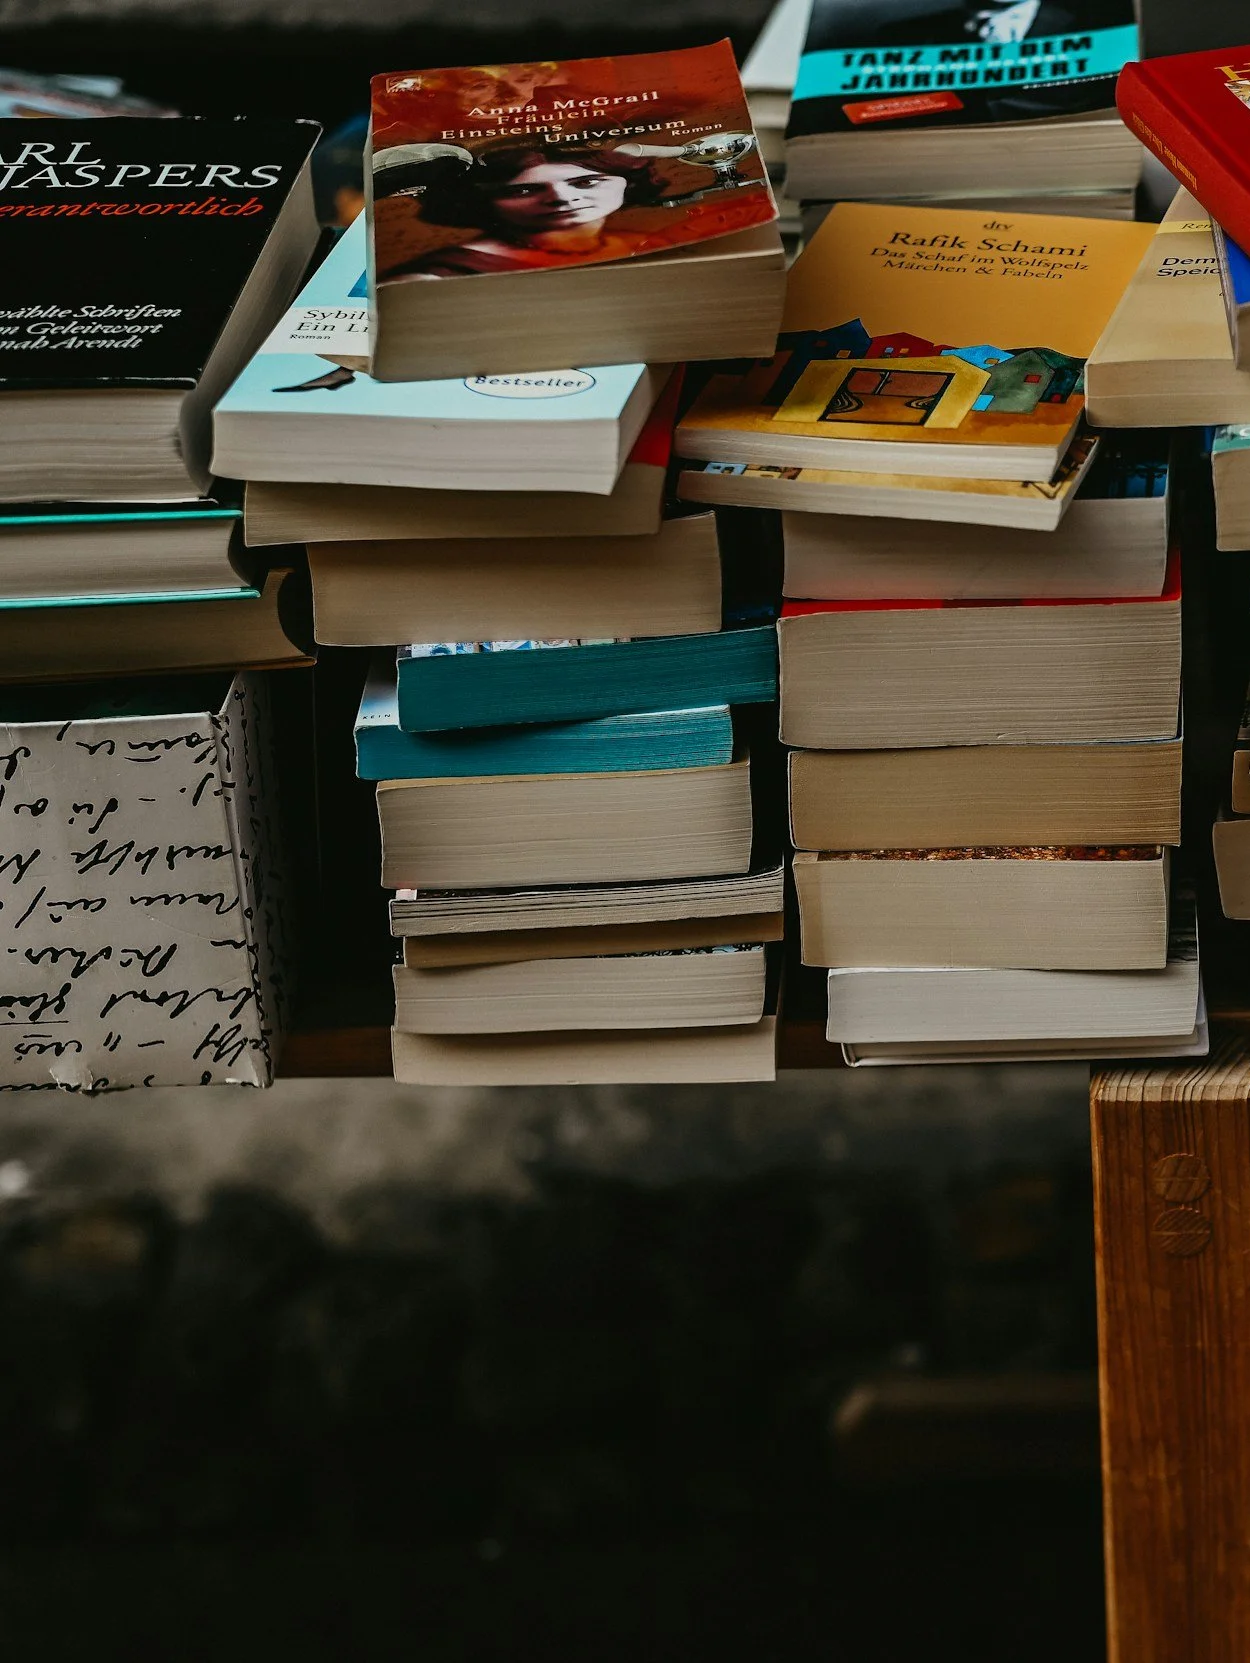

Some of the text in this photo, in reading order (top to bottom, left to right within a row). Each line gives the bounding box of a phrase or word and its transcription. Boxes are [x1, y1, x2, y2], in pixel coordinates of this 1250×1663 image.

[841, 36, 1092, 67] TANZ MIT DEM
[841, 58, 1090, 90] JAHRHUNDERT
[468, 91, 660, 117] Anna McGrail
[497, 108, 606, 125] Fräulein
[441, 123, 563, 140] Einsteins
[544, 118, 723, 143] Universum Roman
[0, 142, 101, 165] RL
[0, 164, 282, 191] JASPERS
[983, 221, 1015, 231] dtv
[889, 232, 1088, 257] Rafik Schami
[871, 248, 1089, 271] Das Schaf im Wolfspelz
[1162, 257, 1219, 266] Dem
[881, 260, 1064, 280] Märchen & Fabeln
[73, 304, 182, 320] Schriften
[304, 309, 370, 321] Sybil
[27, 321, 163, 335] Geleitwort
[297, 322, 335, 332] Ein
[49, 335, 143, 349] Arendt
[475, 376, 584, 388] Bestseller
